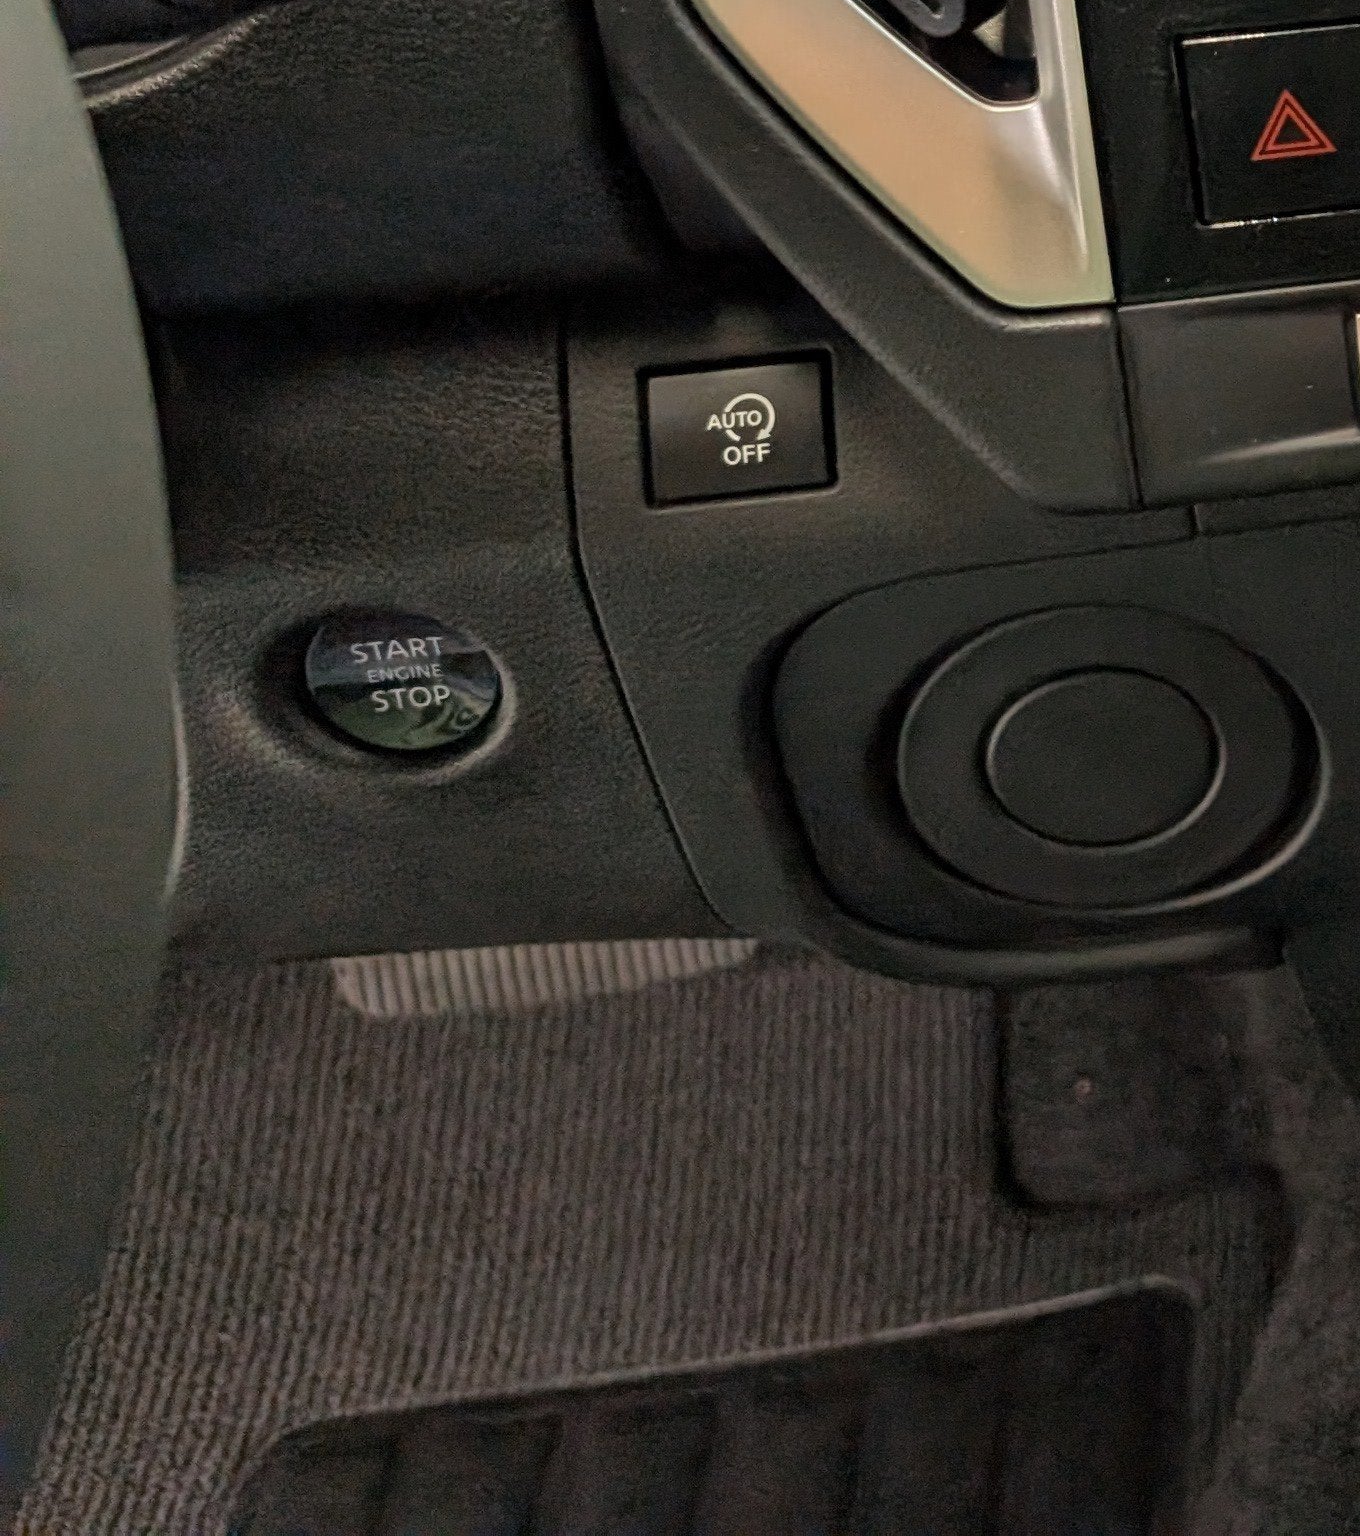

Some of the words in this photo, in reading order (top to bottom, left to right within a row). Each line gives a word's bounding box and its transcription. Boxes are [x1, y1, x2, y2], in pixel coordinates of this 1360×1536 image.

[706, 409, 763, 431] AUTO
[723, 442, 771, 466] OFF
[350, 636, 443, 664] START
[365, 663, 444, 683] ENGINE
[371, 684, 451, 712] STOP
